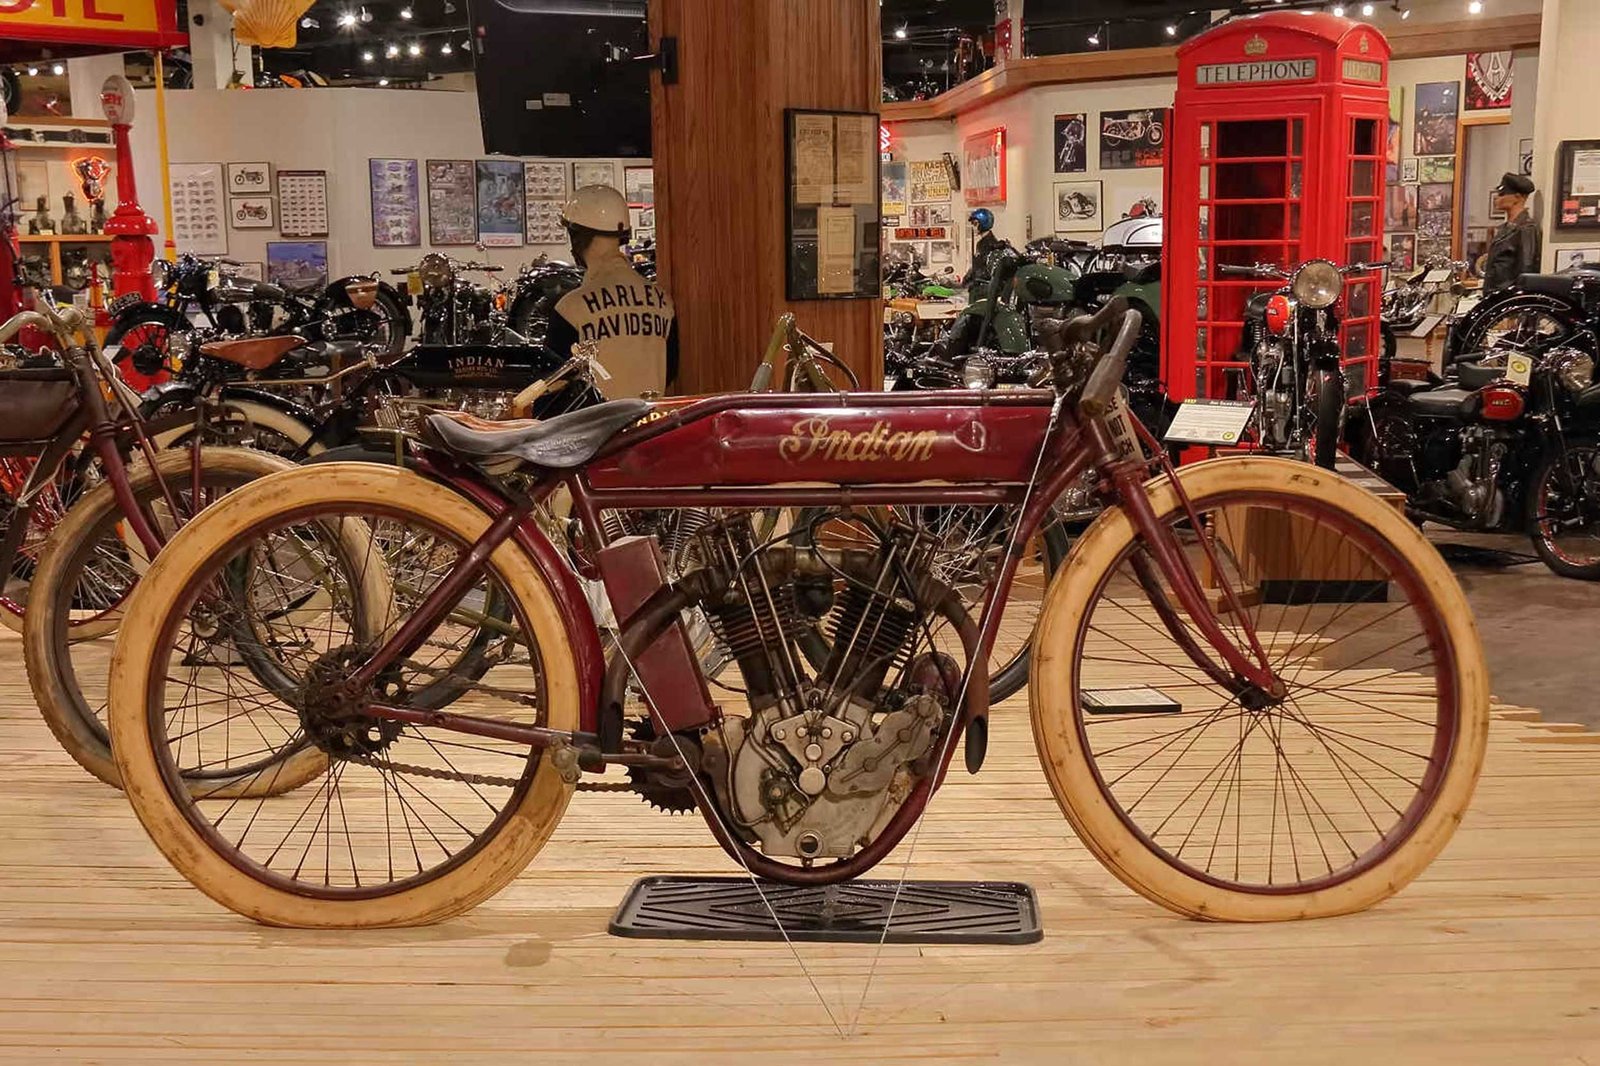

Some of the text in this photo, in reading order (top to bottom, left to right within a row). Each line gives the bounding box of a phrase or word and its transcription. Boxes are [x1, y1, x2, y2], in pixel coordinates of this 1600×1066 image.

[1202, 61, 1314, 83] TELEPHONE
[448, 356, 504, 369] INDIAN
[779, 414, 937, 463] Indian
